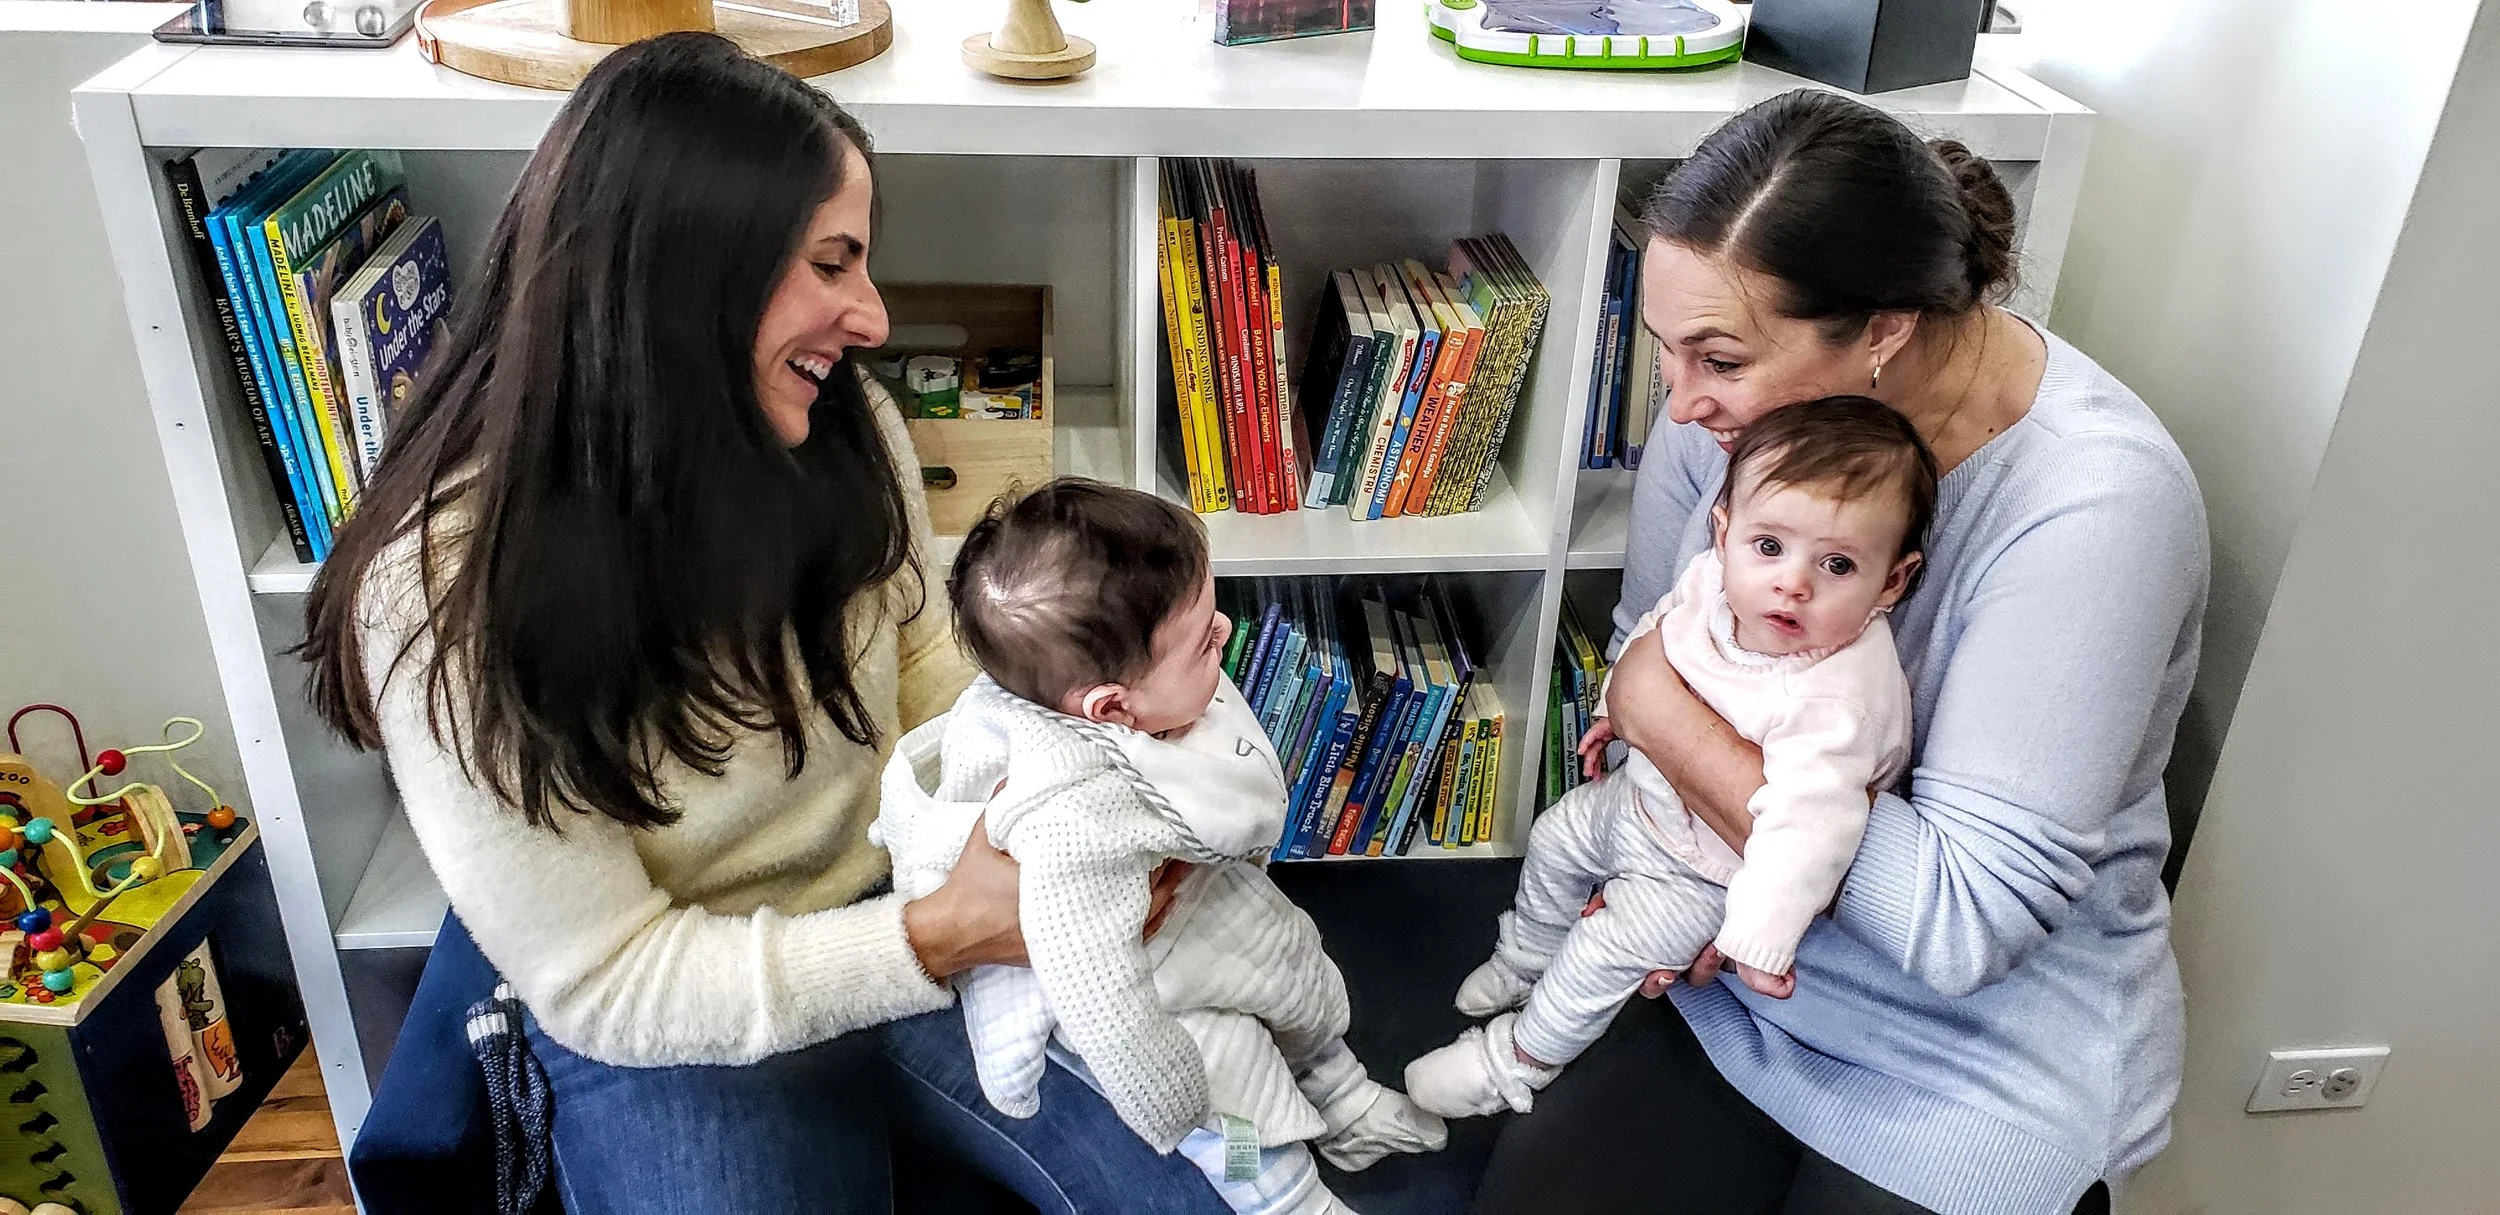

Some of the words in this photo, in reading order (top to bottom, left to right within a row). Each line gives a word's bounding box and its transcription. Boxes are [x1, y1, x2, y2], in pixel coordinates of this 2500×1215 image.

[176, 180, 191, 197] De
[179, 195, 209, 241] Brunhoff
[282, 160, 375, 259] MADELINE
[1168, 230, 1176, 246] REY
[1232, 260, 1244, 303] FREEMAN
[1271, 277, 1279, 298] ethan
[269, 236, 294, 299] MADELINE
[291, 312, 306, 344] LUDWIG
[300, 344, 320, 392] BEMELMANS
[1272, 299, 1280, 315] long
[215, 296, 244, 354] BABAR'S
[379, 325, 408, 371] Under
[406, 309, 425, 343] the
[423, 282, 446, 322] Stars
[1193, 318, 1208, 363] FINDING
[1237, 327, 1253, 363] Corduroy
[1253, 328, 1264, 366] BABAR'S
[1184, 347, 1196, 372] Curious
[1228, 354, 1242, 393] DINOSAUR
[233, 354, 260, 406] MUSEUM
[1200, 364, 1214, 404] WINNIE
[1256, 367, 1267, 392] YOGA
[1233, 393, 1245, 415] FARM
[1259, 392, 1268, 406] for
[1275, 371, 1291, 422] Chamelia
[1443, 398, 1456, 416] How
[250, 405, 265, 424] OF
[354, 394, 376, 439] Under
[1259, 405, 1272, 443] Elephants
[1408, 393, 1440, 455] WEATHER
[1440, 413, 1451, 424] to
[256, 422, 273, 448] ART
[1431, 421, 1448, 448] Babysit
[363, 438, 381, 463] the
[1362, 435, 1387, 495] CHEMISTRY
[1374, 439, 1402, 506] ASTRONOMY
[1420, 451, 1437, 480] Grandpa
[1404, 699, 1422, 726] EDWARD
[1423, 688, 1440, 716] Roald
[1341, 731, 1368, 769] Natalie
[1356, 700, 1380, 733] Sisson
[1414, 716, 1429, 740] Dahl
[1442, 723, 1453, 740] Does
[1320, 739, 1345, 775] Little
[1475, 744, 1484, 760] Blue
[1566, 749, 1575, 763] All
[1312, 772, 1332, 801] Blue
[1422, 778, 1432, 791] Use
[1298, 796, 1323, 835] Truck
